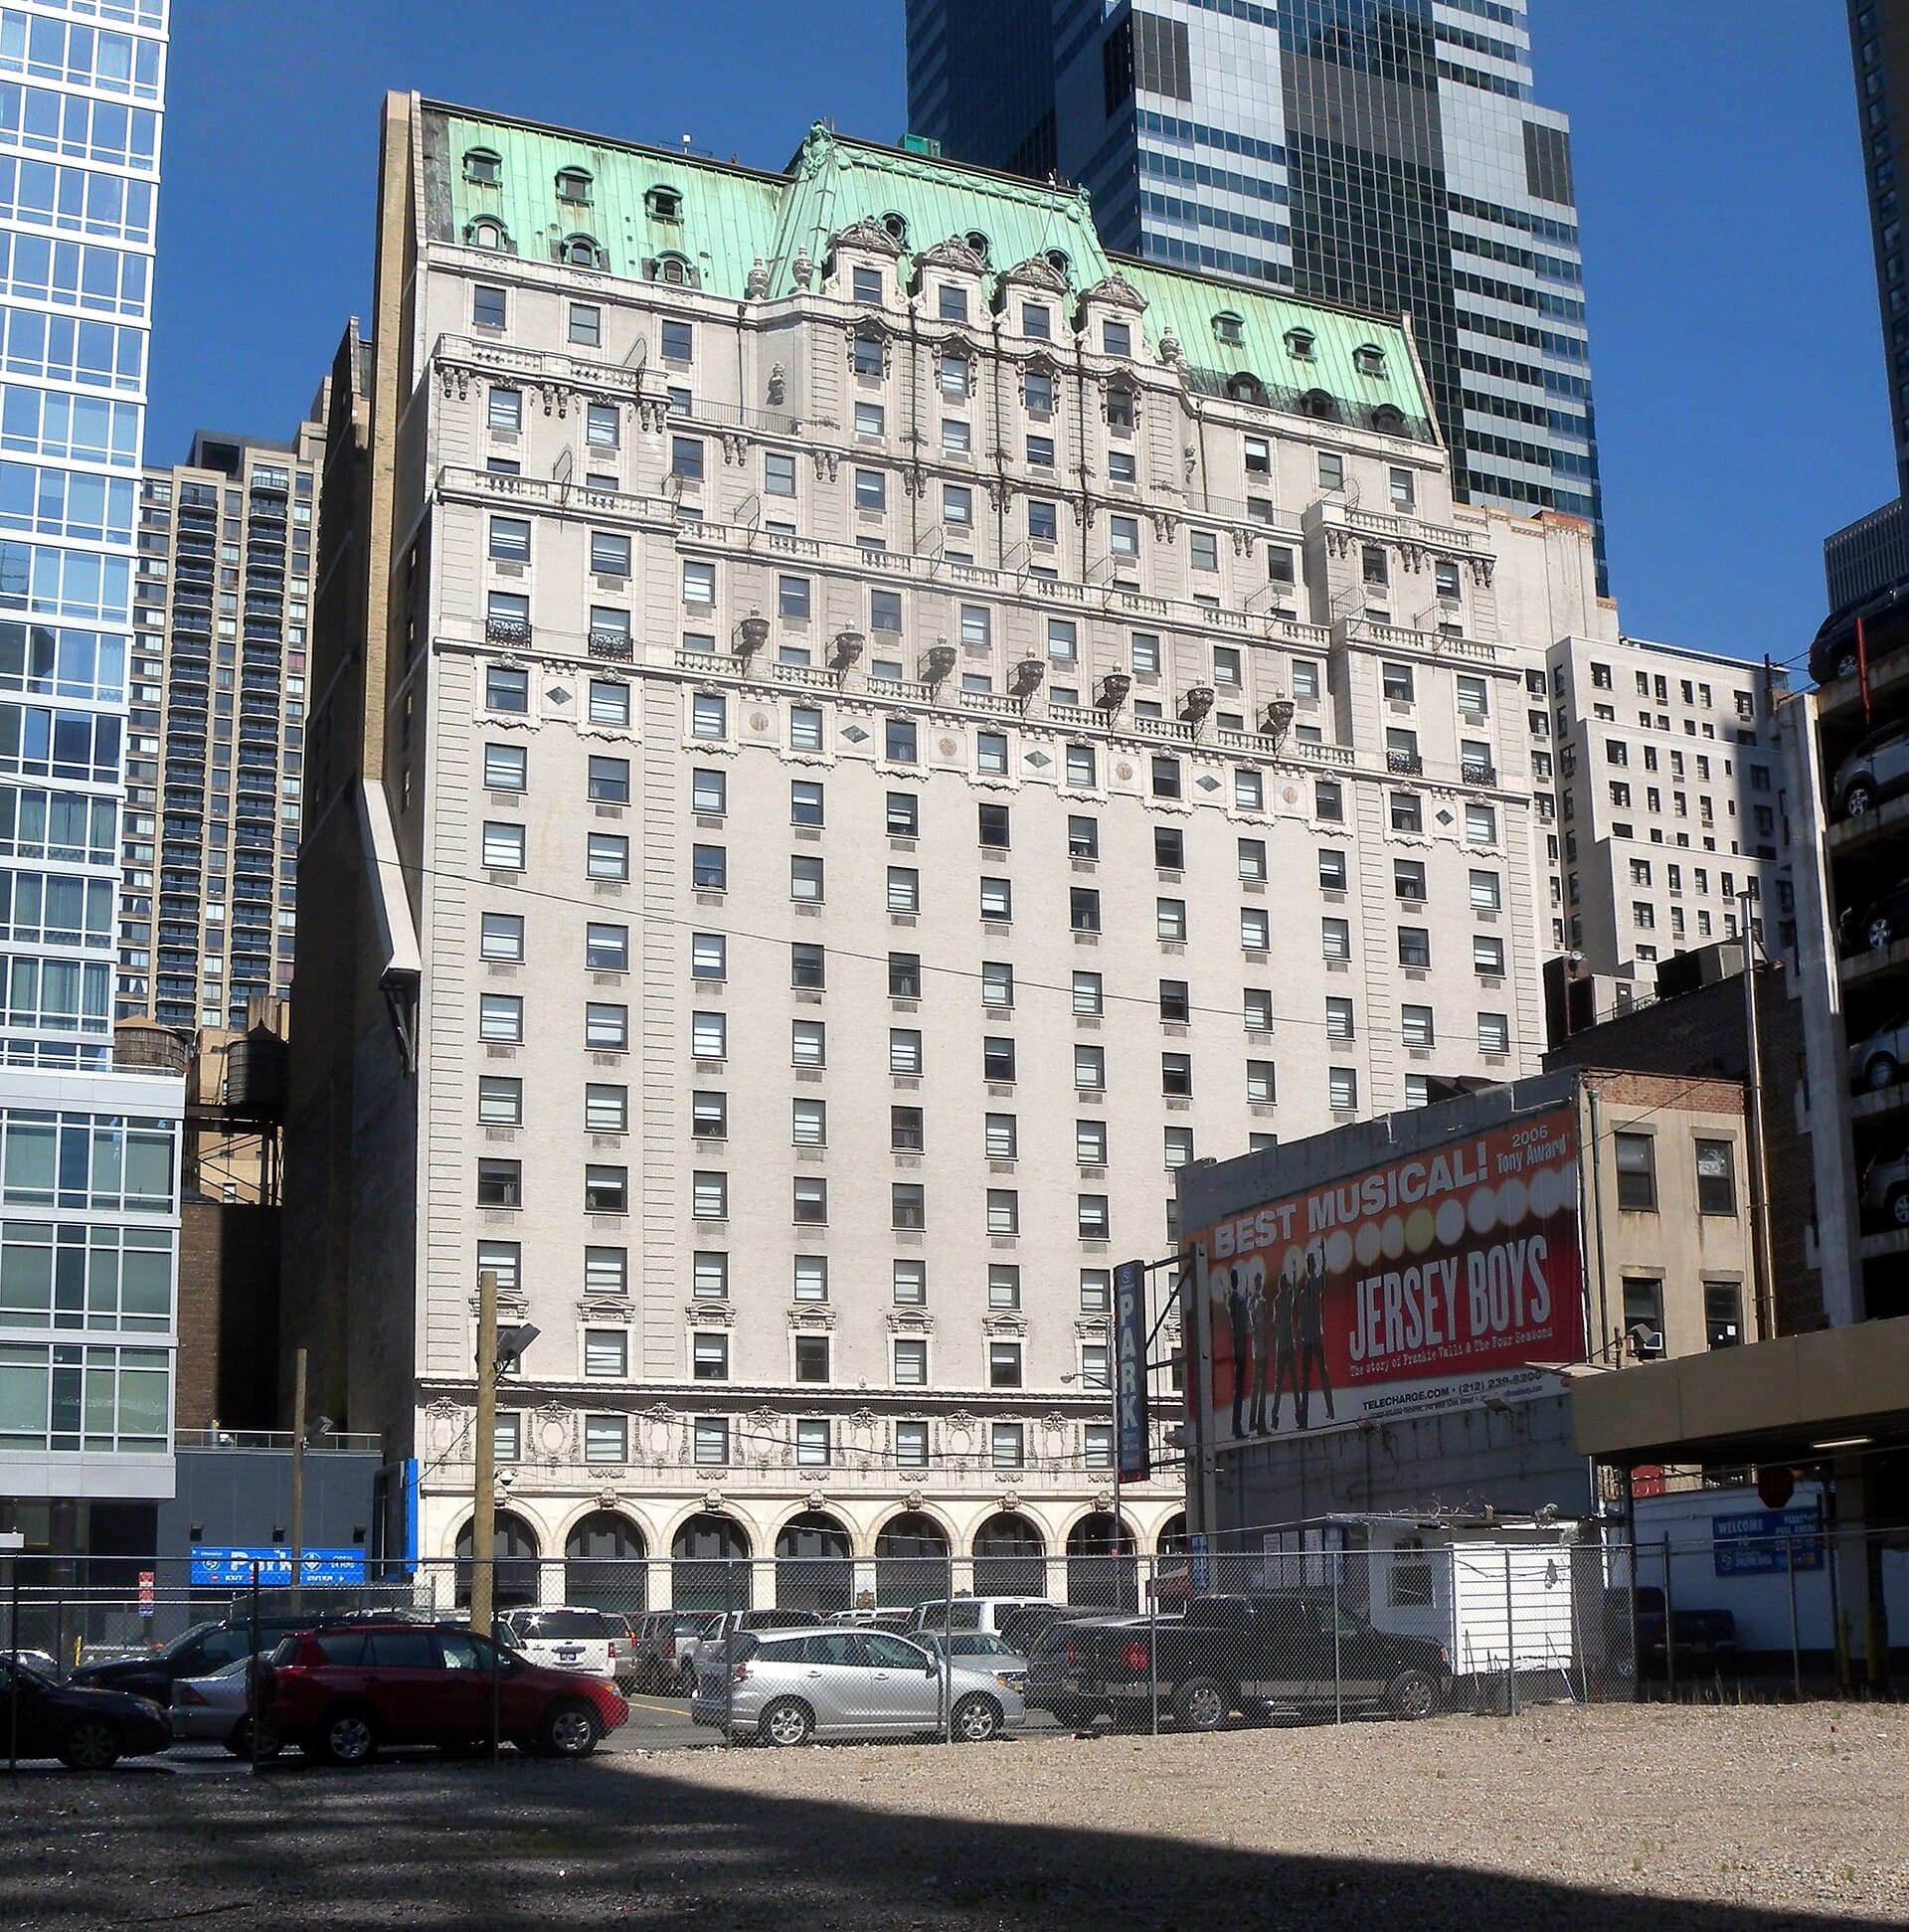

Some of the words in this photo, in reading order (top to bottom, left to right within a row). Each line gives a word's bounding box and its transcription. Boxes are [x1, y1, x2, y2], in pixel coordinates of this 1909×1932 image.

[1496, 1150, 1523, 1175] Tony
[1526, 1134, 1567, 1166] Award
[1511, 1125, 1549, 1148] 2006
[1214, 1202, 1298, 1261] BEST
[1307, 1141, 1488, 1233] MUSICAL!
[1348, 1257, 1458, 1361] JERSEY
[1468, 1234, 1551, 1336] BOYS
[1120, 1293, 1138, 1430] PARK
[1350, 1365, 1364, 1377] The
[1366, 1357, 1390, 1374] story
[1392, 1355, 1402, 1367] of
[1403, 1350, 1437, 1366] Frankie
[1439, 1344, 1464, 1360] Valli
[1492, 1336, 1512, 1348] Four
[1515, 1327, 1554, 1344] Seasons
[1362, 1387, 1450, 1411] TELECHARGE.COM
[1459, 1381, 1485, 1397] (212)
[1717, 1518, 1764, 1535] WELCOME
[231, 1551, 294, 1572] Park
